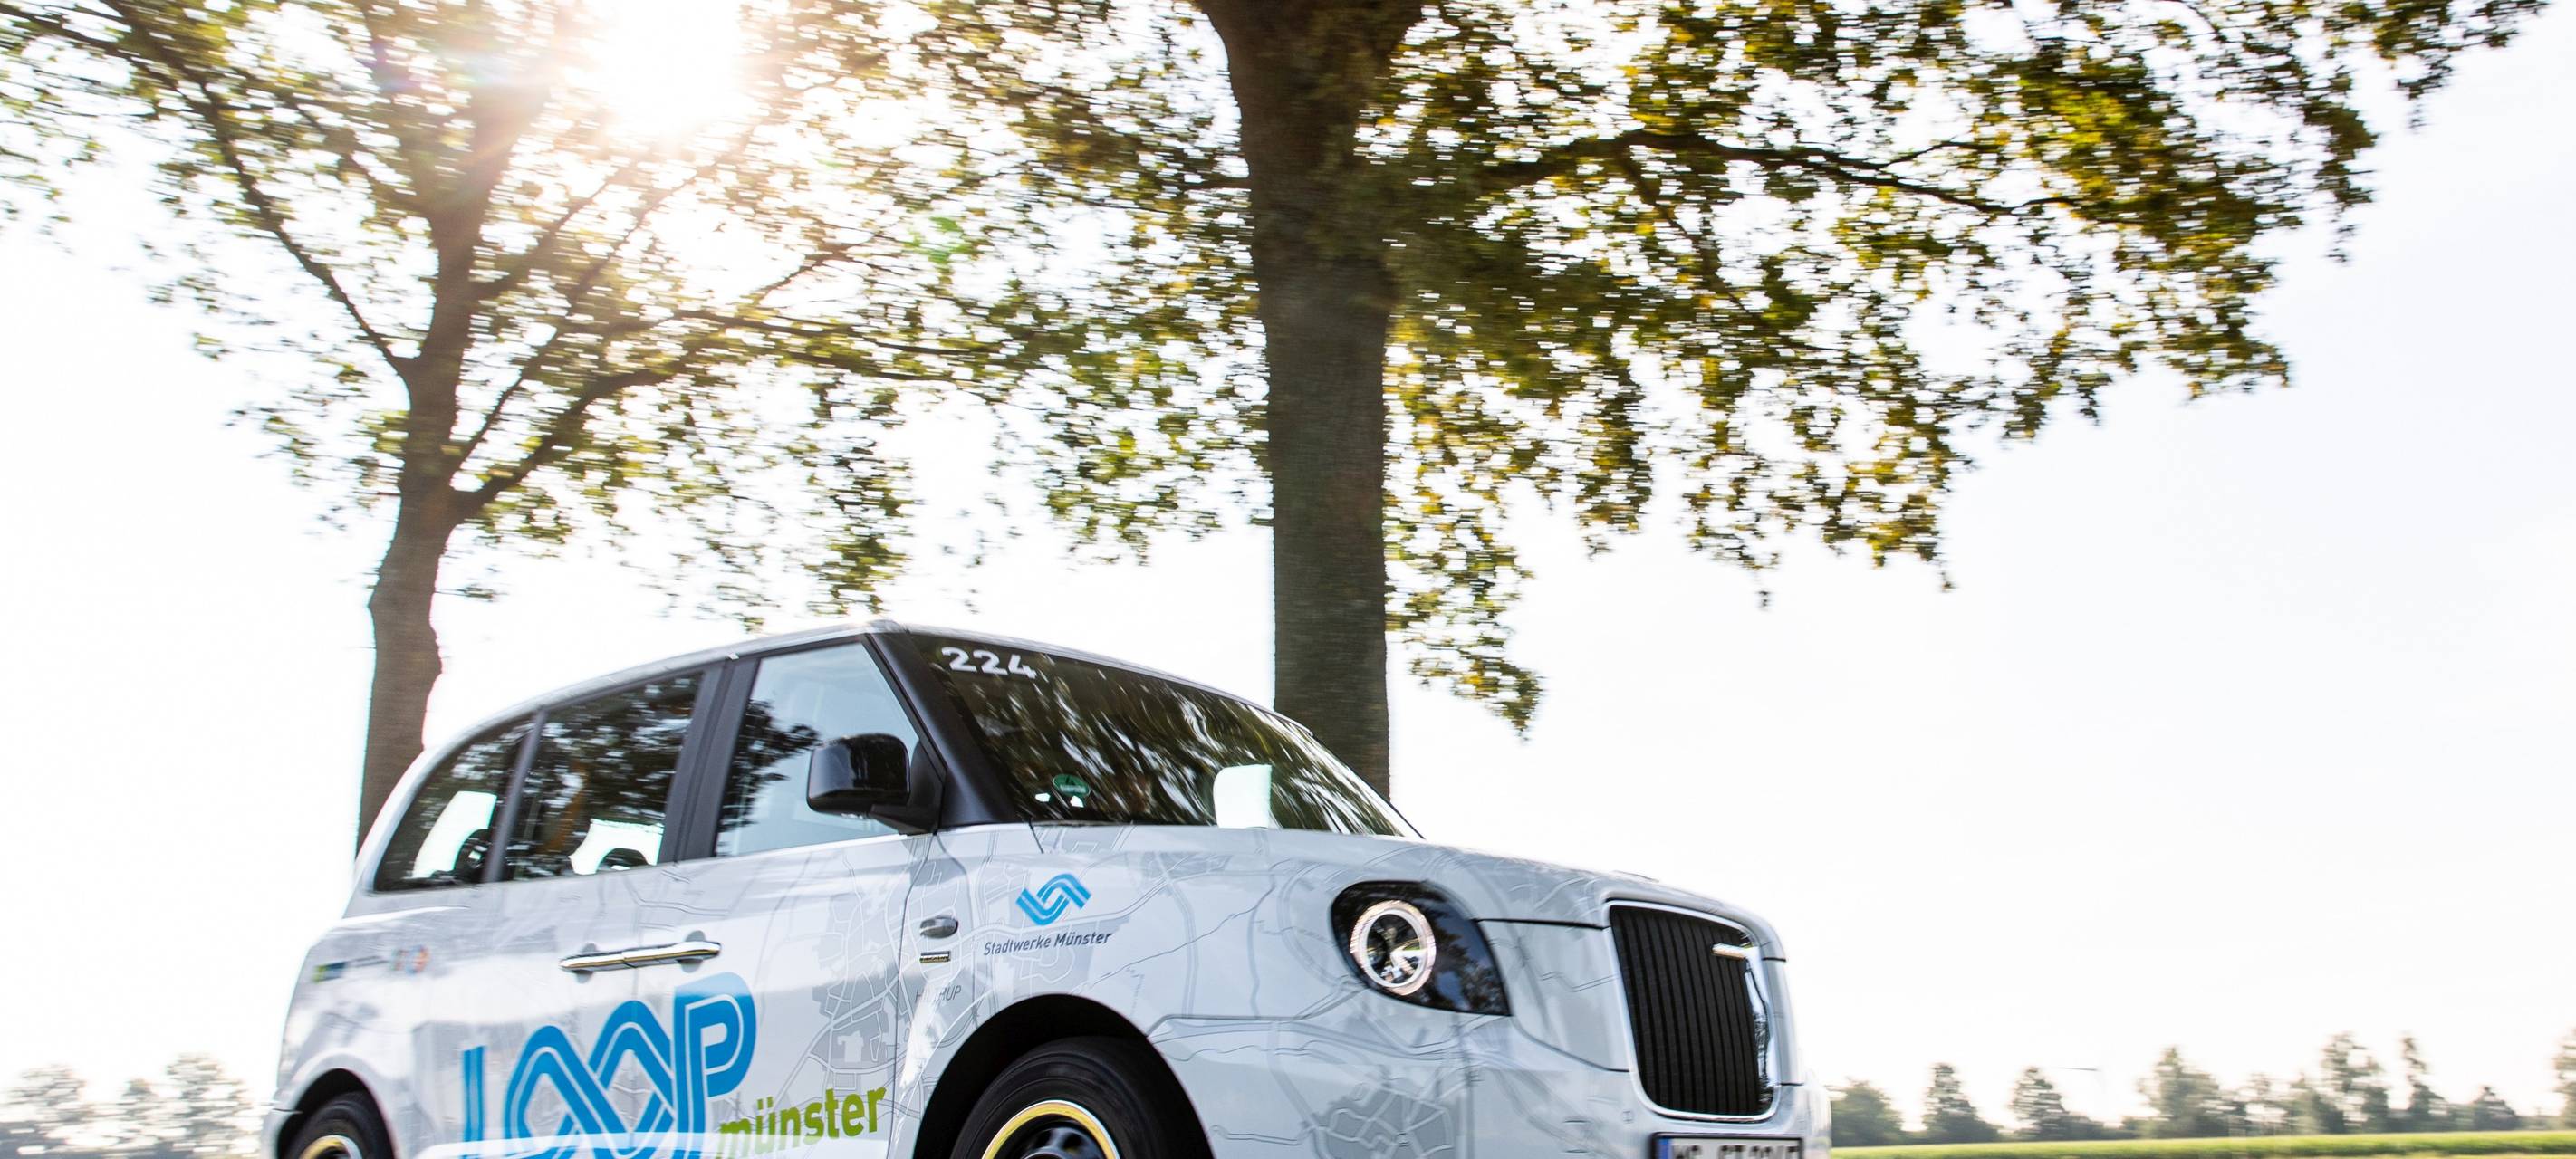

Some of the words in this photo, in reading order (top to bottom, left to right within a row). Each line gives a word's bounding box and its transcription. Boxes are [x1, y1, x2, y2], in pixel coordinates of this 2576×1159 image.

[941, 647, 1037, 679] 224
[984, 936, 1052, 956] Stadtwerke
[1053, 931, 1114, 947] Münster
[714, 1087, 887, 1159] münster
